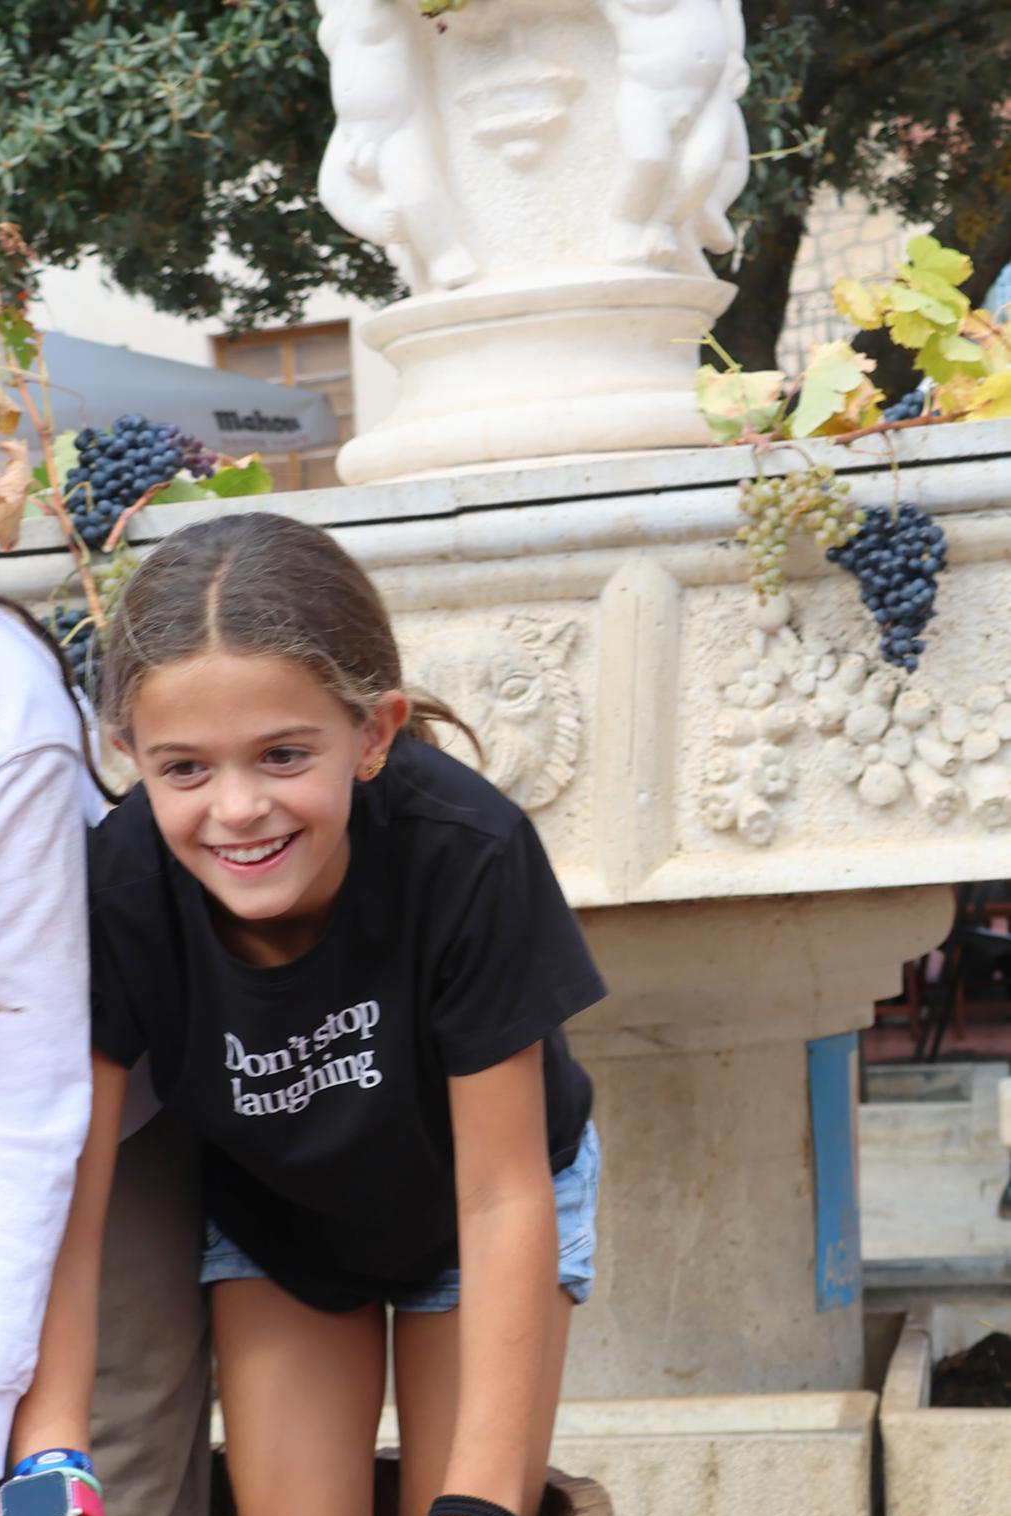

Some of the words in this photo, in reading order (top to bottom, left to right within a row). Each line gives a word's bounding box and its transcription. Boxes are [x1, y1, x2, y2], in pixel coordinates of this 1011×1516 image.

[224, 1032, 311, 1077] Don't
[313, 1000, 380, 1050] stop
[230, 1050, 383, 1116] laughing
